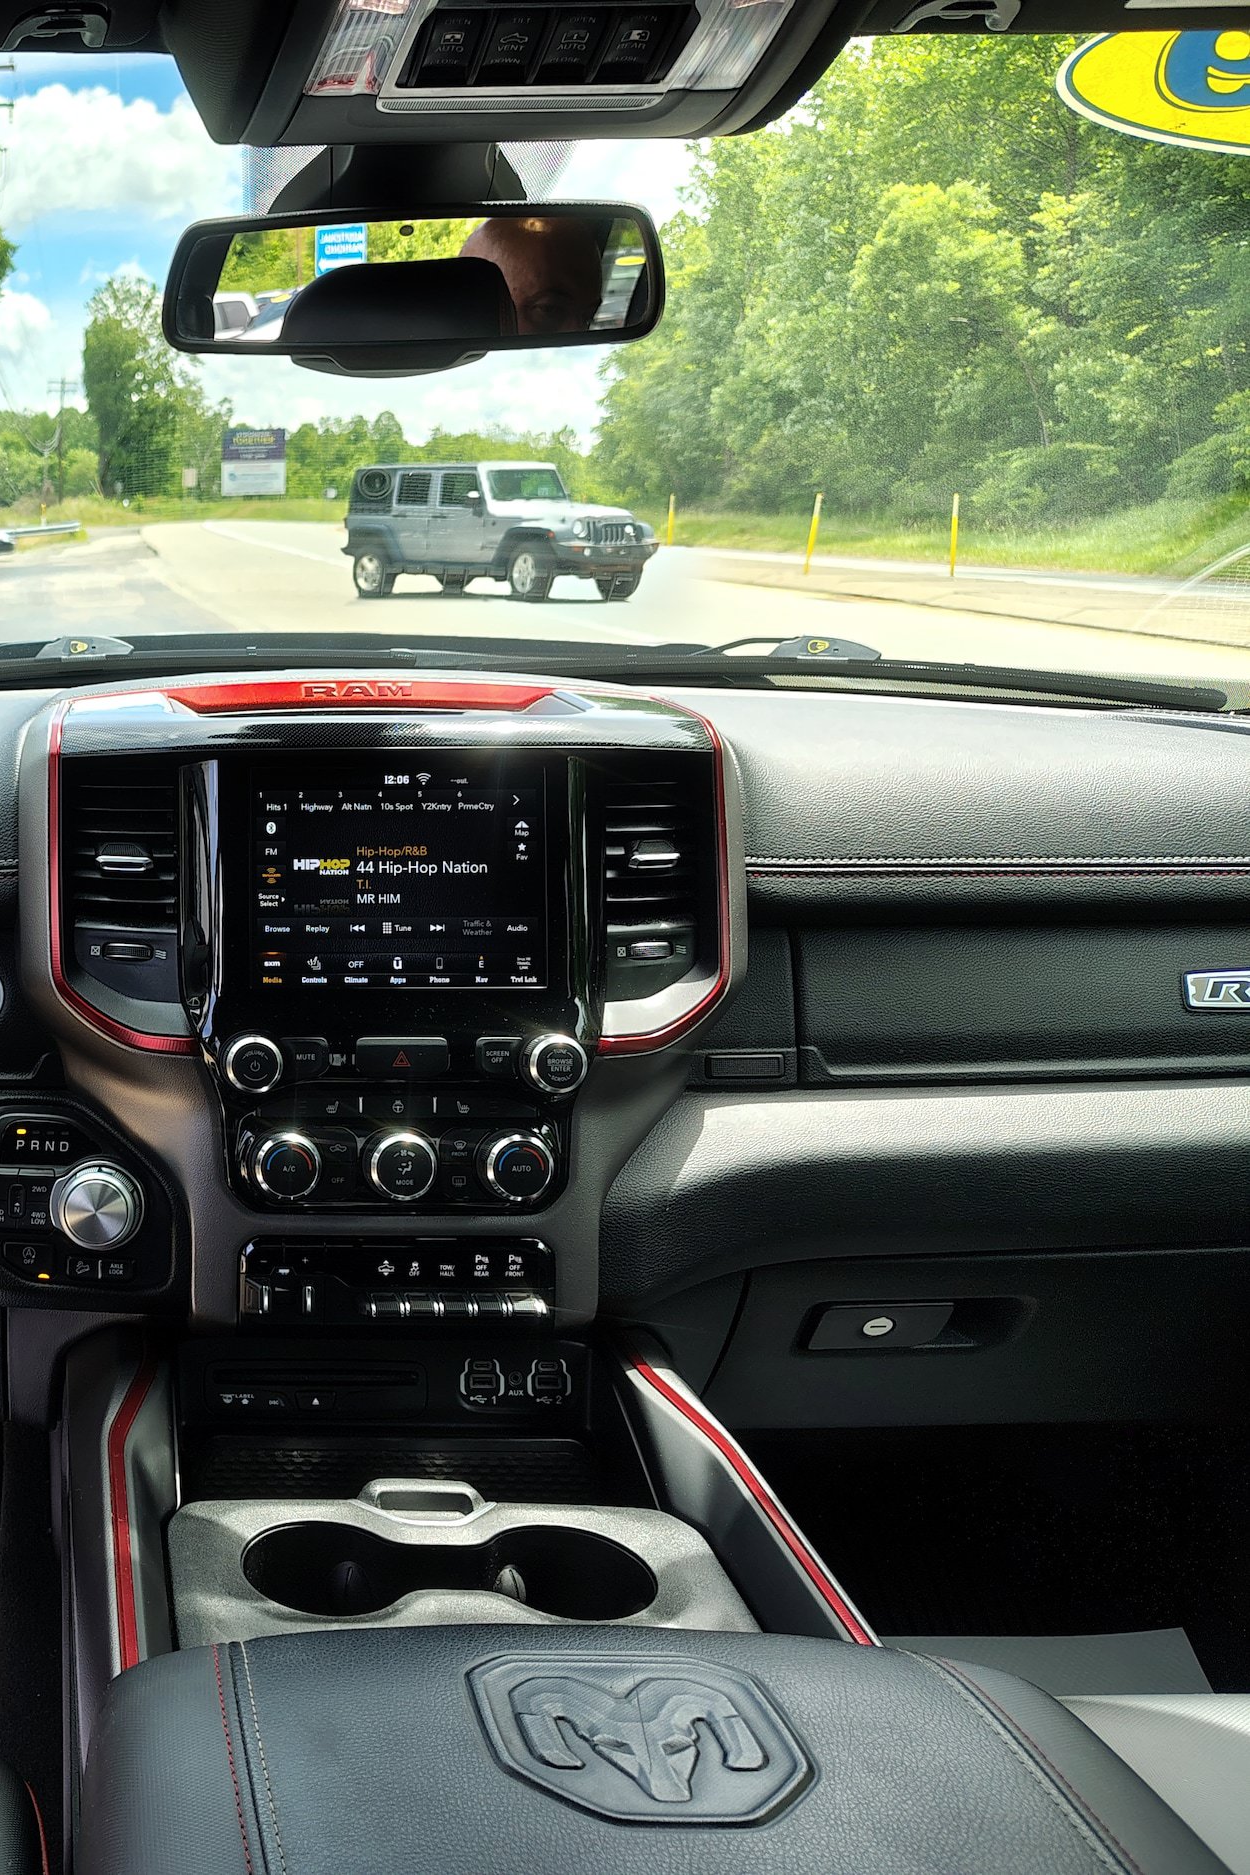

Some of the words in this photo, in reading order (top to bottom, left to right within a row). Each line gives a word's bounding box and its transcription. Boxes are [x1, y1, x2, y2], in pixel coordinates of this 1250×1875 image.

[435, 45, 464, 53] AUTO
[497, 44, 524, 52] VENT
[557, 42, 586, 51] AUTO
[301, 682, 412, 698] RAM
[384, 775, 410, 785] 12:06
[266, 803, 282, 811] Hits
[283, 803, 288, 811] 1
[300, 803, 333, 812] Highway
[395, 803, 413, 812] Spot
[422, 803, 451, 812] Y2Kntry
[458, 802, 494, 811] PrmeCtry
[514, 829, 530, 837] Map
[356, 846, 428, 858] Hip-Hop/R&B
[356, 861, 375, 874] 44
[379, 861, 438, 876] Hip-Hop
[442, 861, 488, 874] Nation
[356, 880, 372, 890] T.I.
[258, 893, 279, 901] Source
[356, 894, 375, 904] MR
[378, 894, 401, 904] HIM
[394, 924, 412, 932] Tune
[462, 920, 484, 928] Traffic
[485, 920, 492, 928] &
[507, 924, 528, 932] Audio
[264, 925, 290, 933] Browse
[305, 924, 330, 933] Replay
[462, 928, 493, 936] Weather
[348, 961, 364, 969] OFF
[478, 960, 484, 968] E
[390, 976, 406, 984] Apps
[245, 1050, 265, 1058] VOLUME
[15, 1139, 25, 1150] P
[30, 1140, 40, 1151] R
[45, 1140, 55, 1151] N
[59, 1141, 69, 1152] D
[282, 1165, 296, 1173] A/C
[31, 1185, 47, 1193] 2WD
[491, 1395, 497, 1405] 1
[555, 1395, 563, 1404] 2
